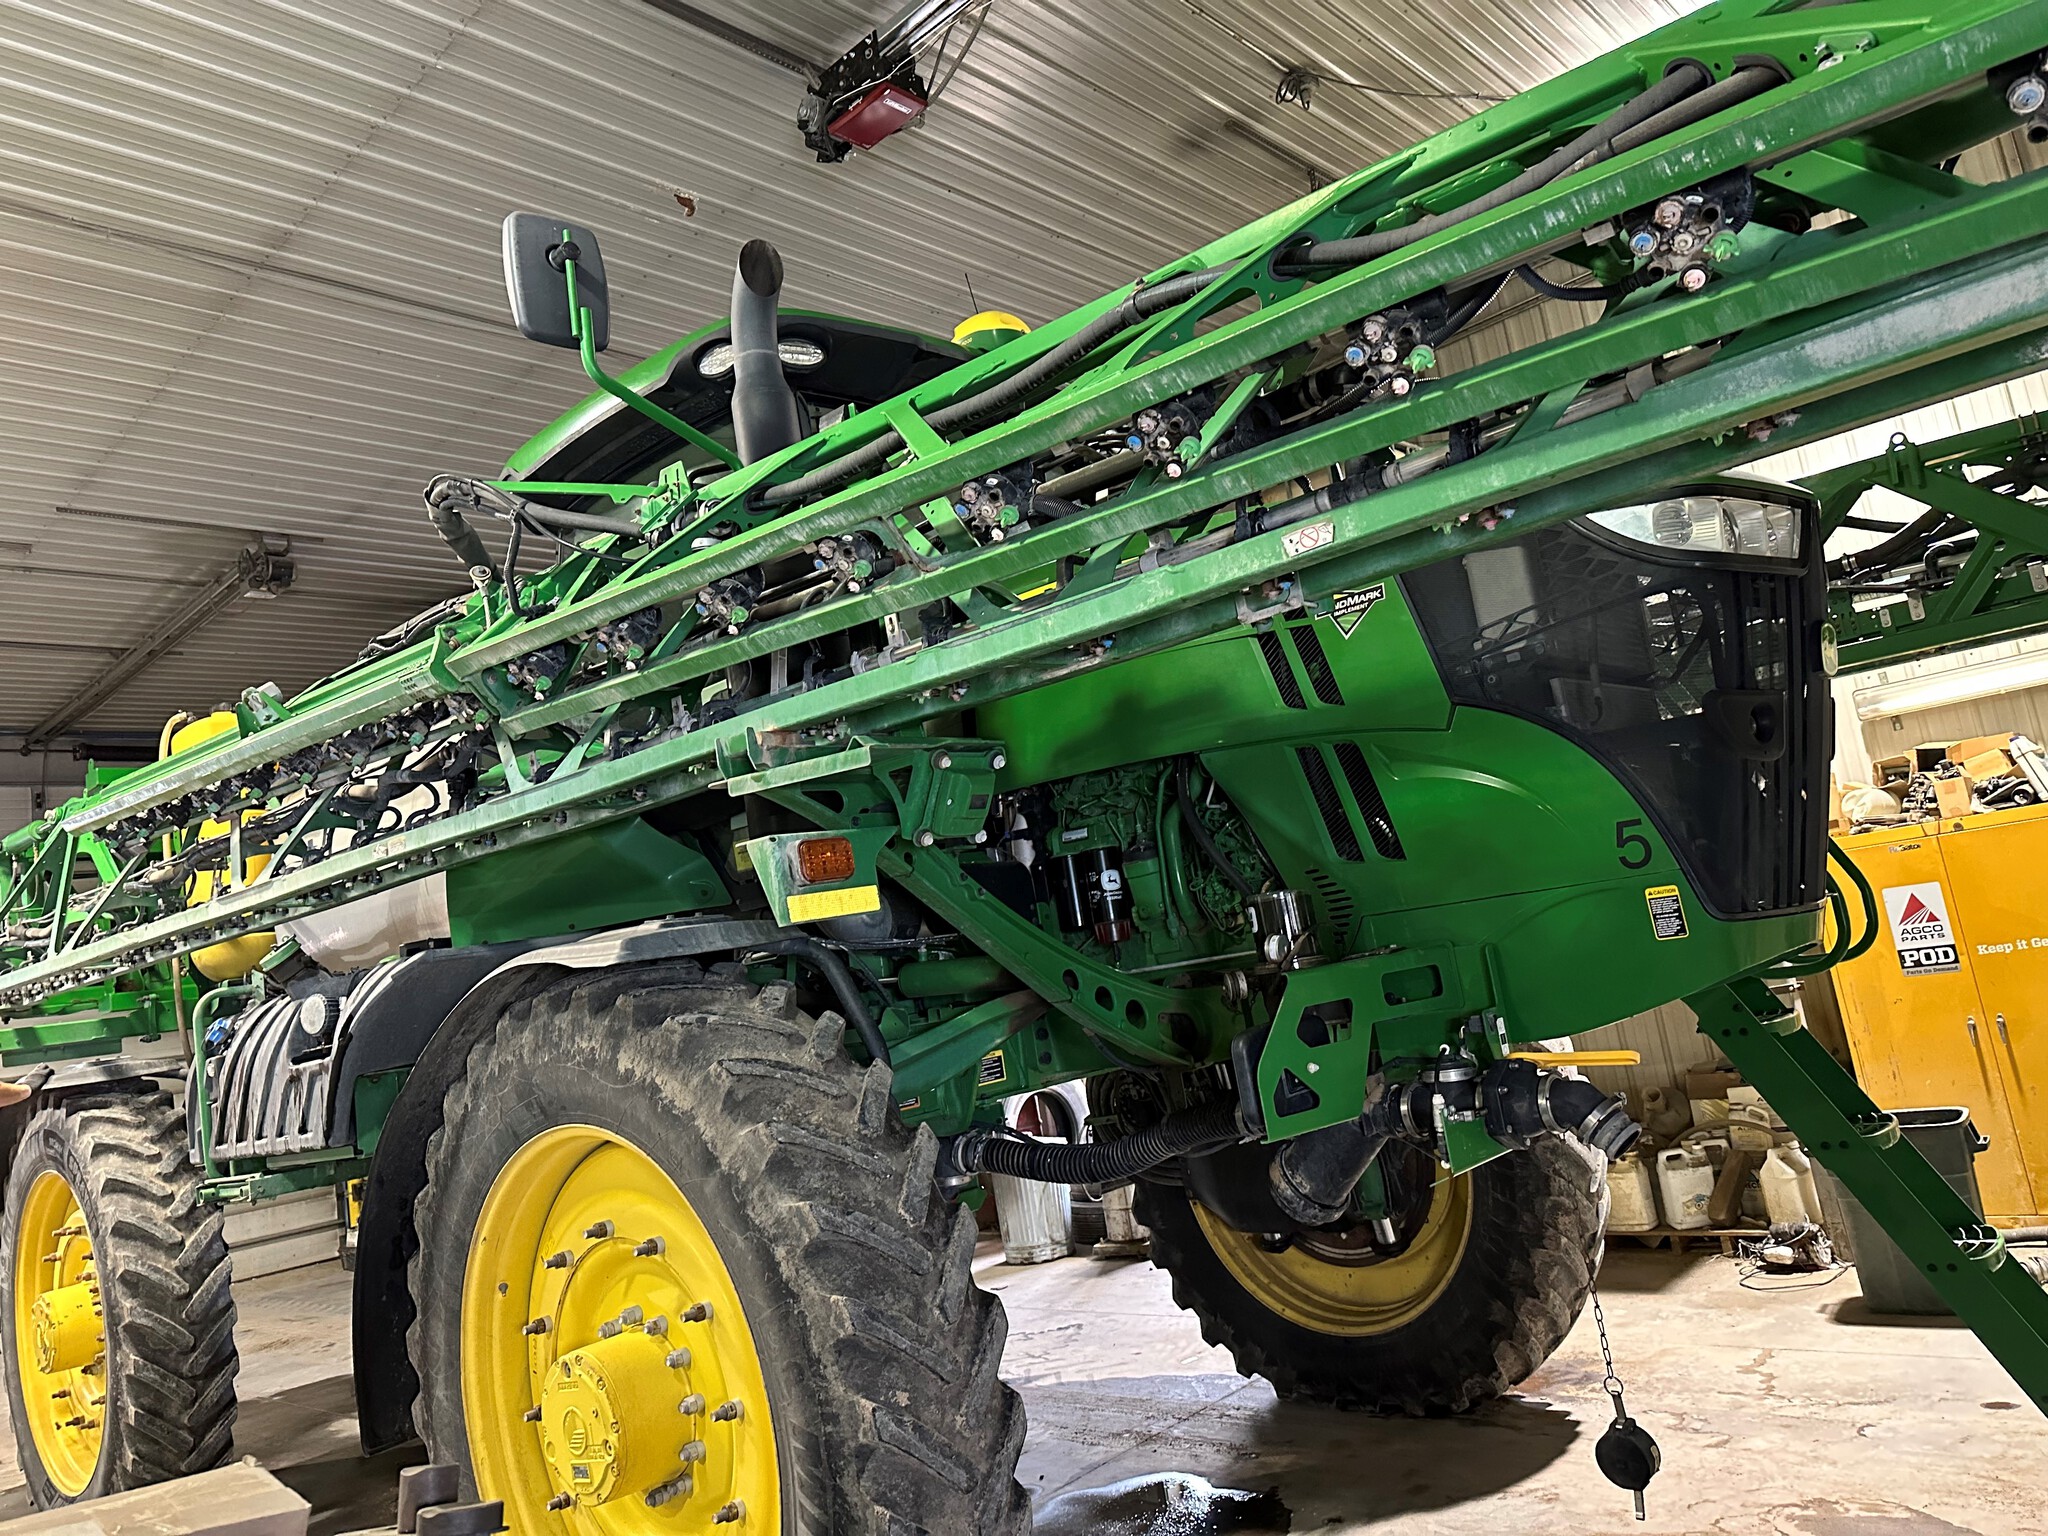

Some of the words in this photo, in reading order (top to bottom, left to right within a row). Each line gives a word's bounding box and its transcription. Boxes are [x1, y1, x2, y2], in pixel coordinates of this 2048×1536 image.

[1335, 589, 1381, 610] NDMARK
[1334, 602, 1368, 616] IMPLEMENT
[1616, 818, 1652, 869] 5
[1901, 924, 1943, 936] AGCO
[1901, 932, 1946, 942] PARTS
[1977, 943, 2013, 955] Keep
[2016, 939, 2028, 950] it
[1901, 947, 1955, 966] POD
[1933, 965, 1959, 973] Demand
